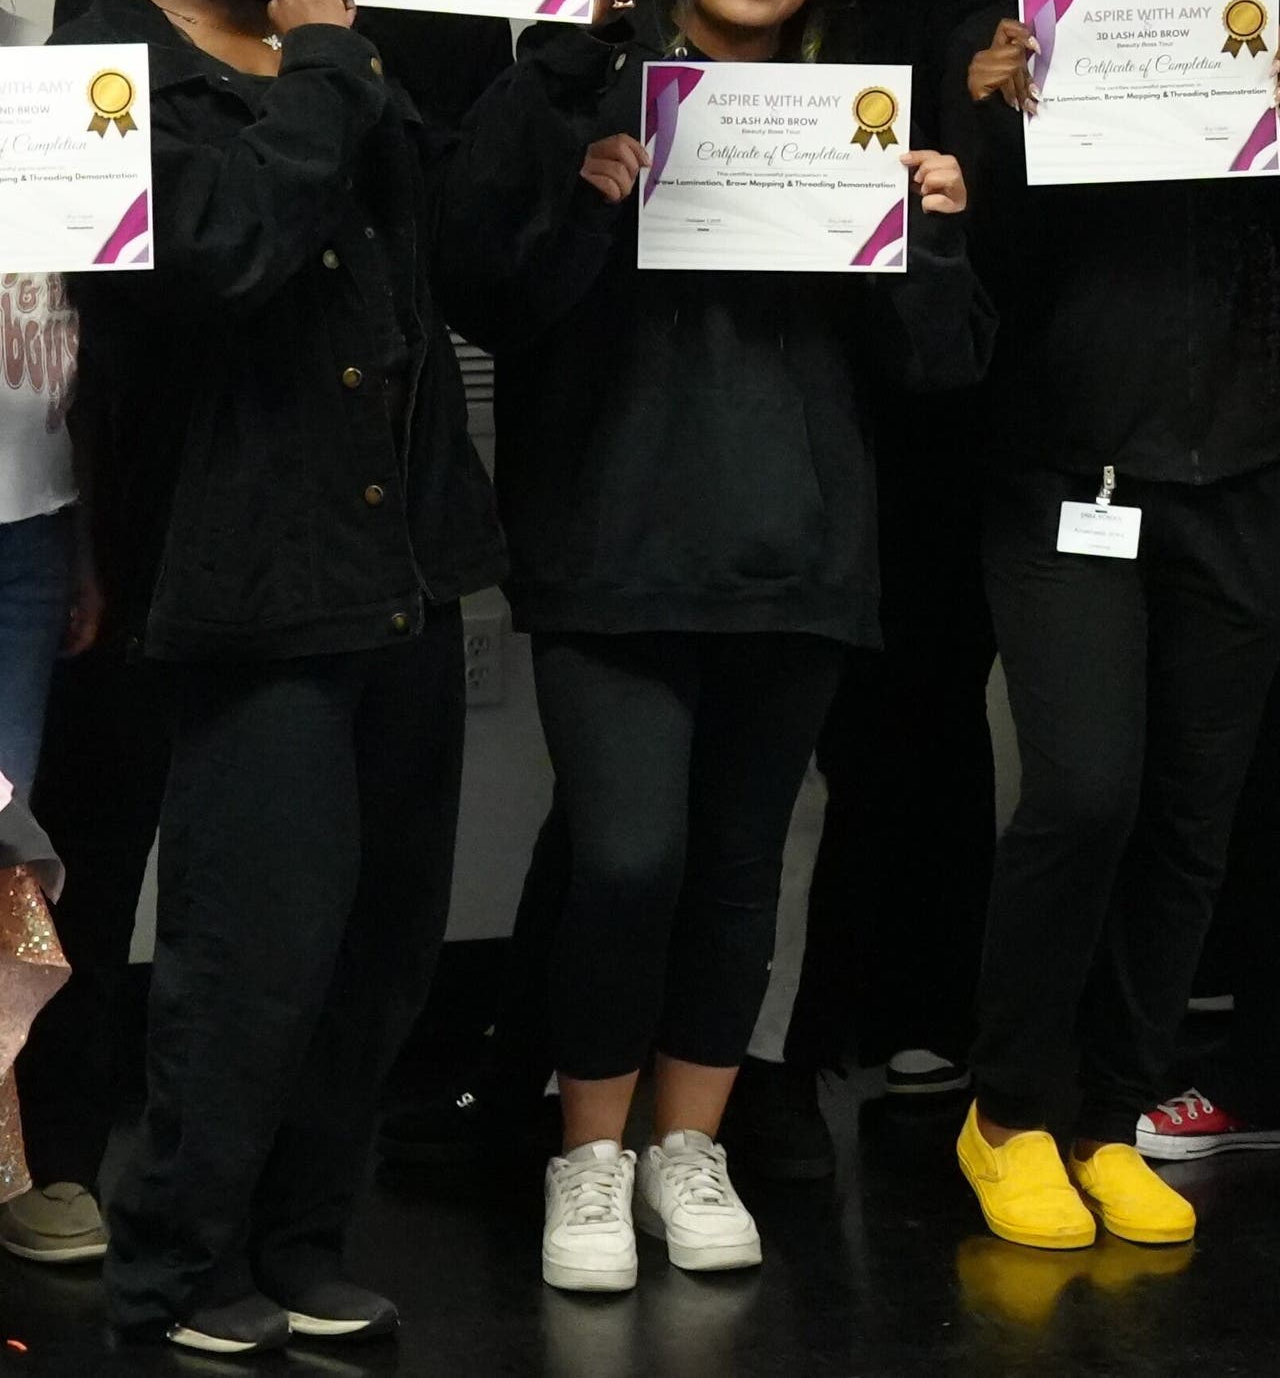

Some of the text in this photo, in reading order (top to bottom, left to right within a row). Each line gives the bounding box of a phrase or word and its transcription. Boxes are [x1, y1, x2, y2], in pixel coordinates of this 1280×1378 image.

[1082, 6, 1212, 23] ASPIRE WITH AMY
[1095, 29, 1190, 41] 3D LASH AND BROW
[1074, 54, 1222, 81] Certificate of Completion
[707, 93, 842, 108] ASPIRE WITH AMY
[18, 105, 50, 114] BROW
[720, 116, 819, 126] 3D LASH AND BROW
[12, 133, 87, 158] Completion
[696, 141, 851, 167] Certificate of Completion
